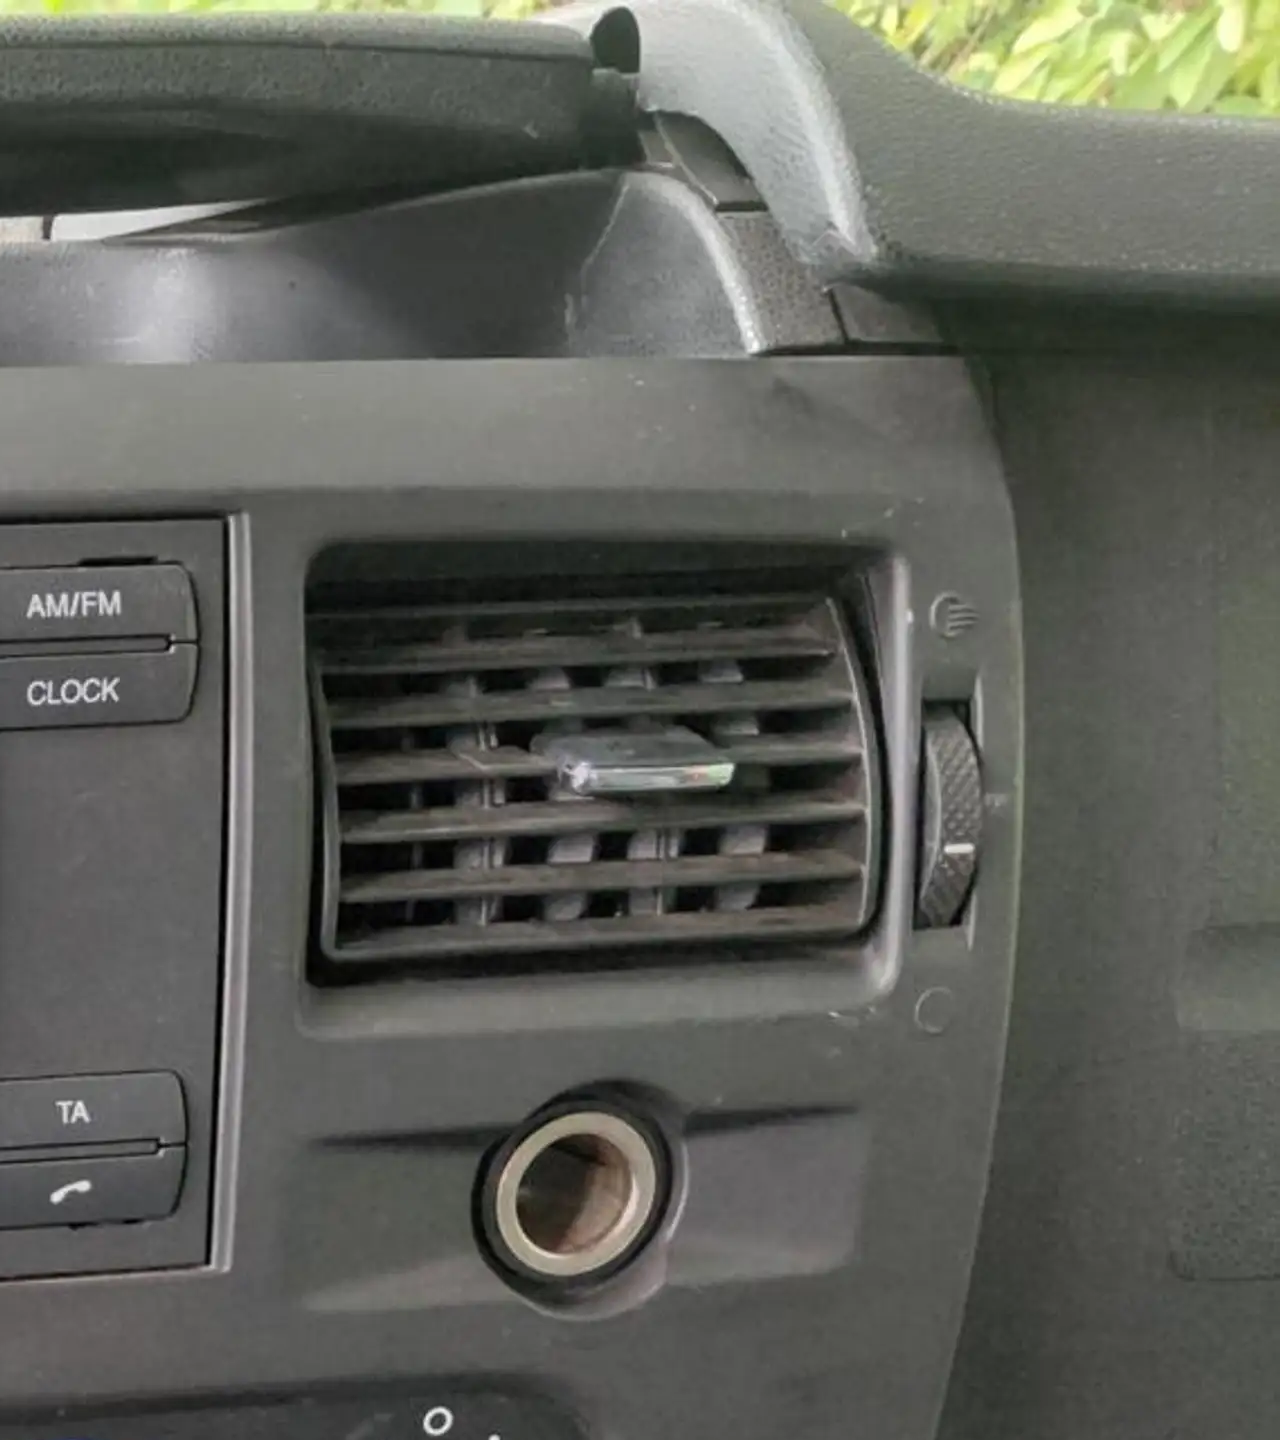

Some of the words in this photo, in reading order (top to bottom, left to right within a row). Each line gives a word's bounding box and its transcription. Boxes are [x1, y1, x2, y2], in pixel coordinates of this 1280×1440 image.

[26, 590, 122, 619] AM/FM
[26, 678, 120, 706] CLOCK
[56, 1100, 90, 1125] TA
